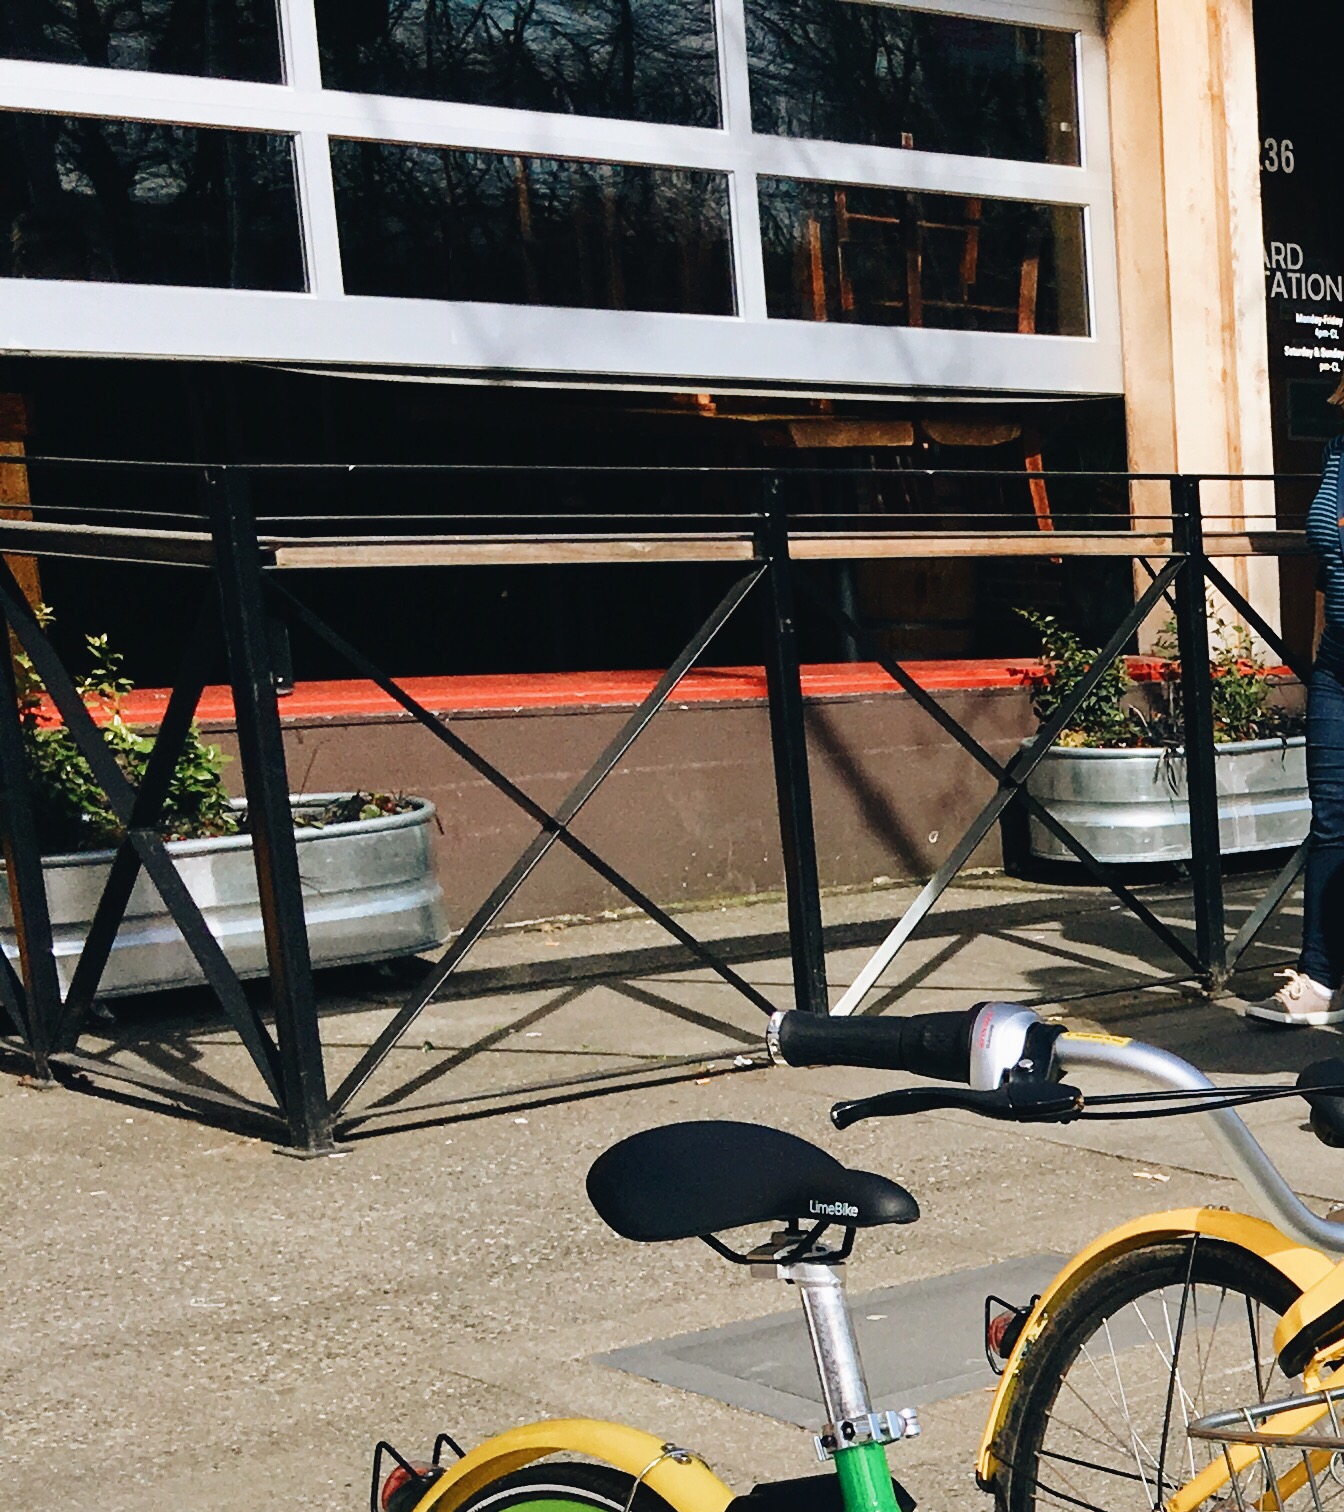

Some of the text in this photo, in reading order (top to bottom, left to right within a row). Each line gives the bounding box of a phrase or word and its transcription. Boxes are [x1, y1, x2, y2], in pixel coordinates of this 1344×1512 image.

[1261, 137, 1295, 174] 36
[1265, 271, 1343, 302] ATION
[809, 1199, 859, 1217] LimeBike
